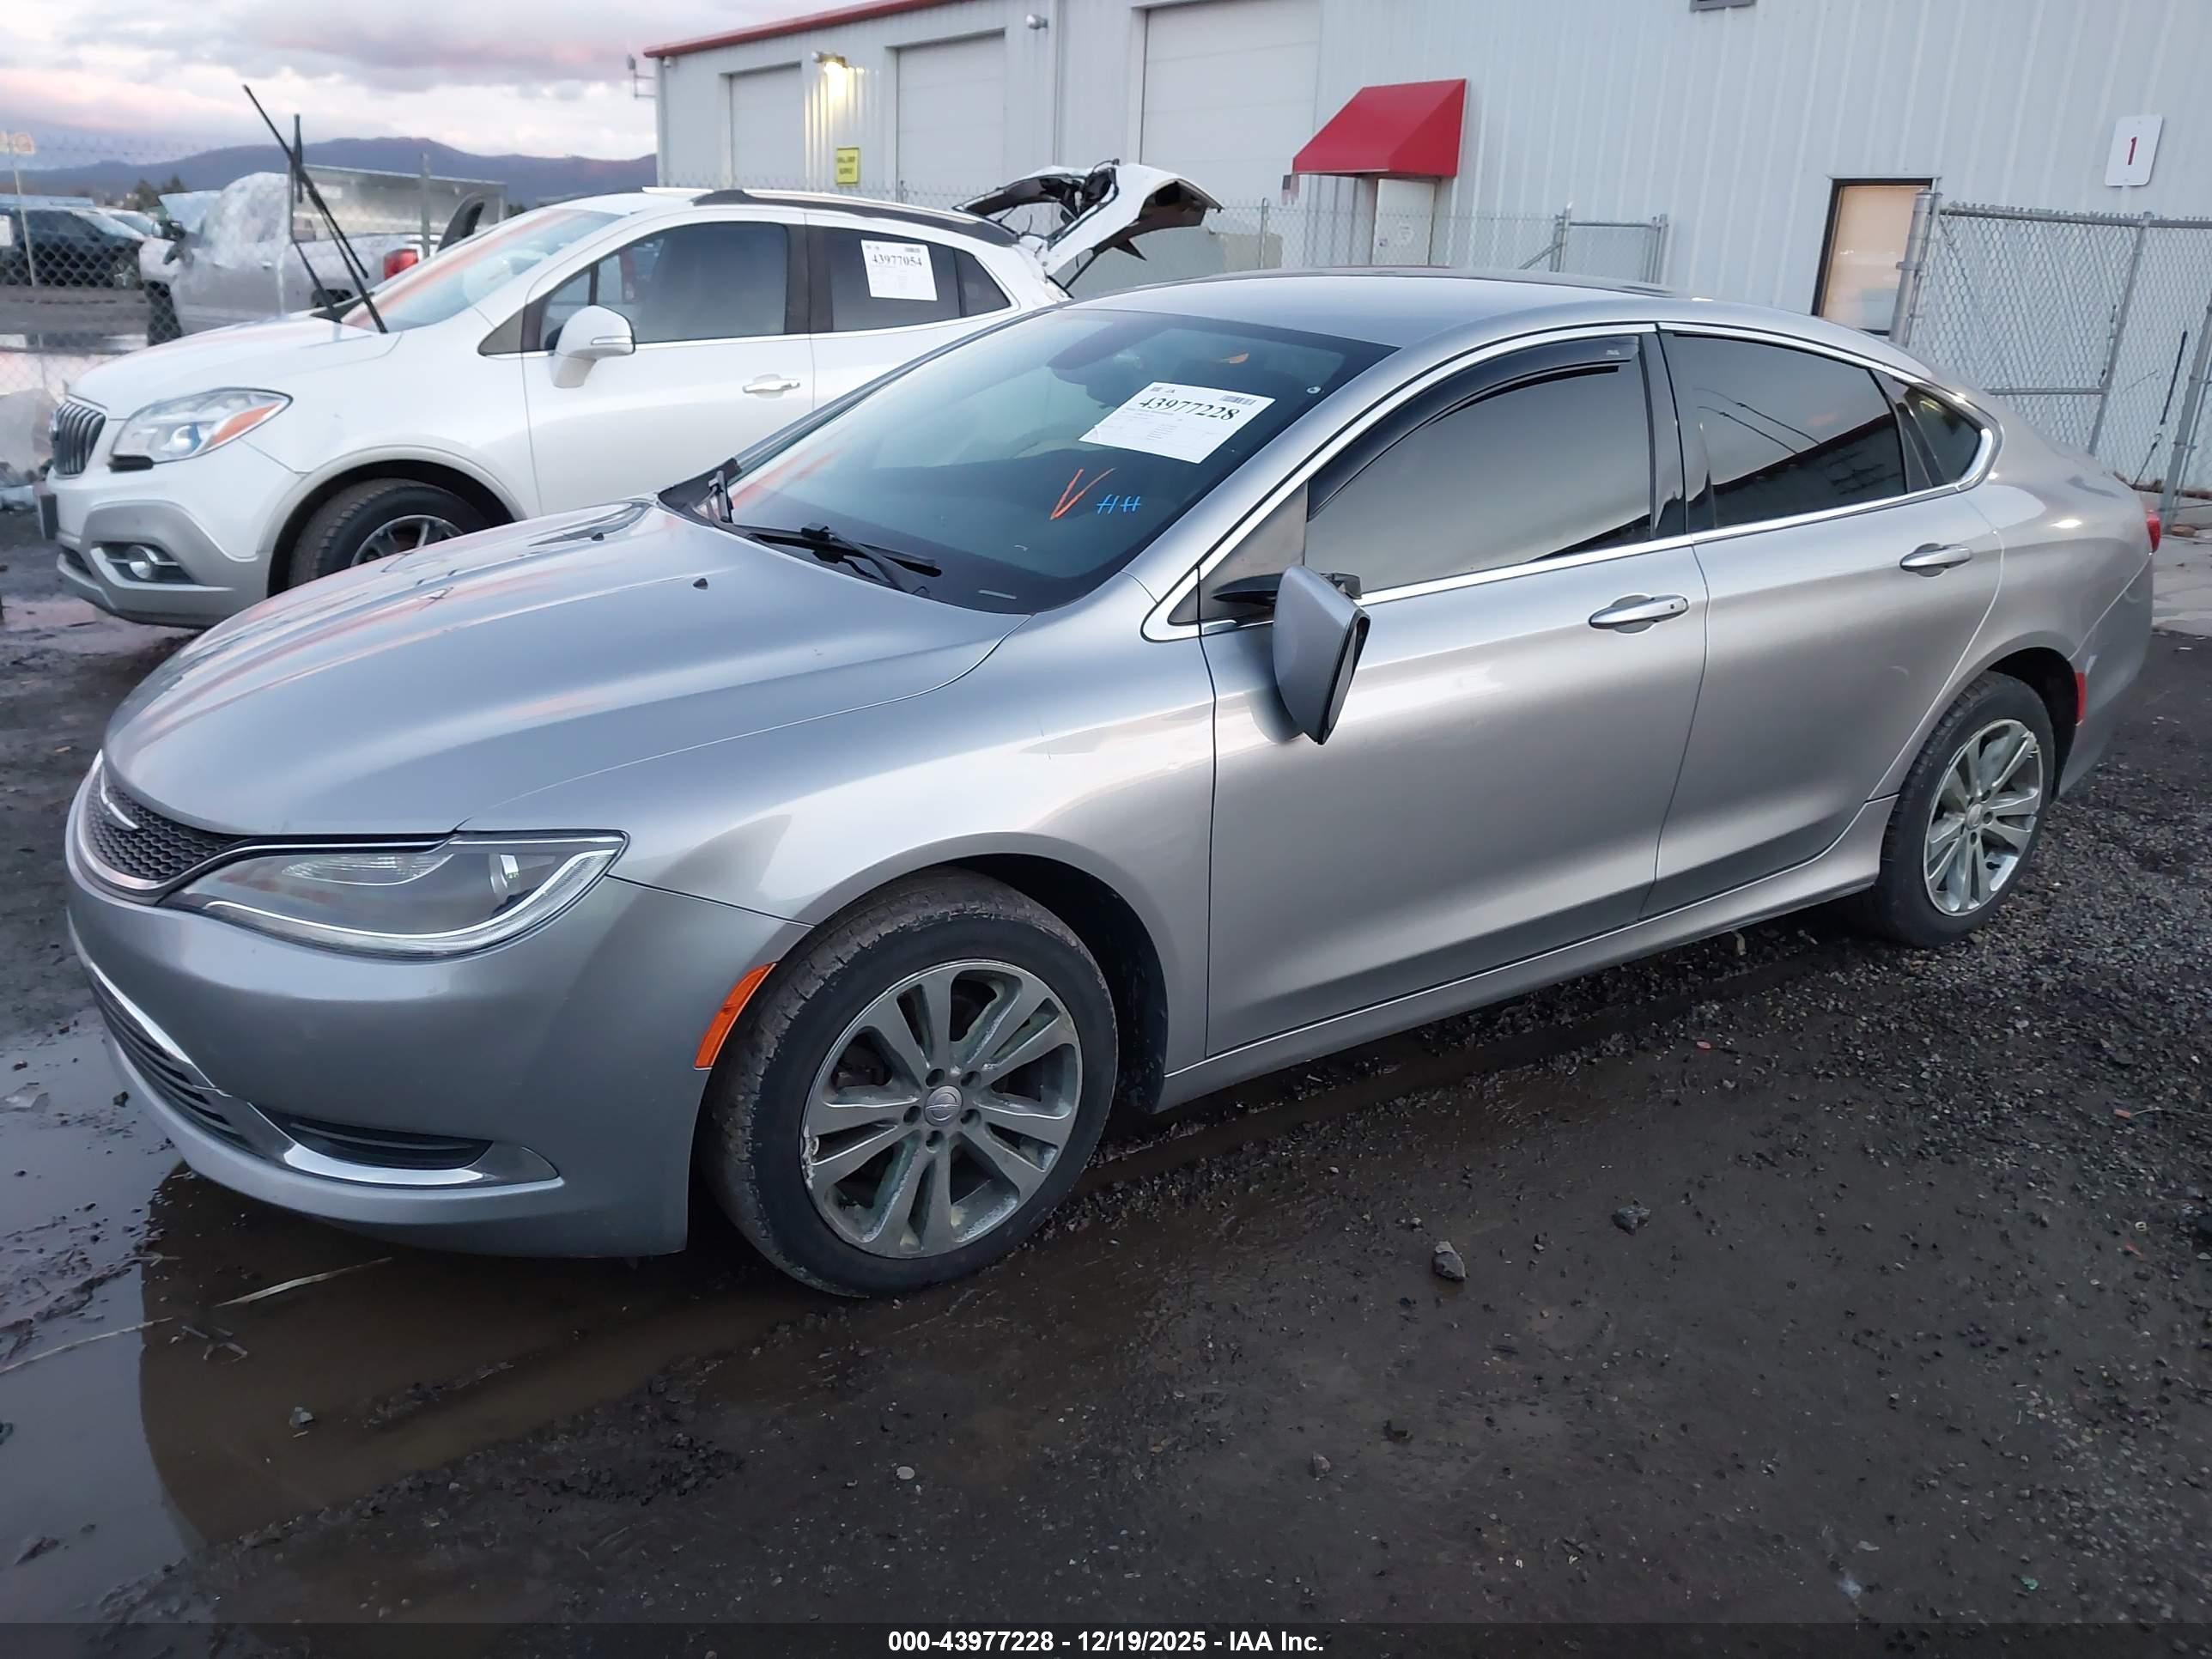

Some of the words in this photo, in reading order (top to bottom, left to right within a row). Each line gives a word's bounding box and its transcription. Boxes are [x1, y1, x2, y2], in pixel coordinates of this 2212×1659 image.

[2127, 136, 2138, 166] 1
[872, 253, 922, 267] 43977054
[1139, 397, 1241, 421] 43977228
